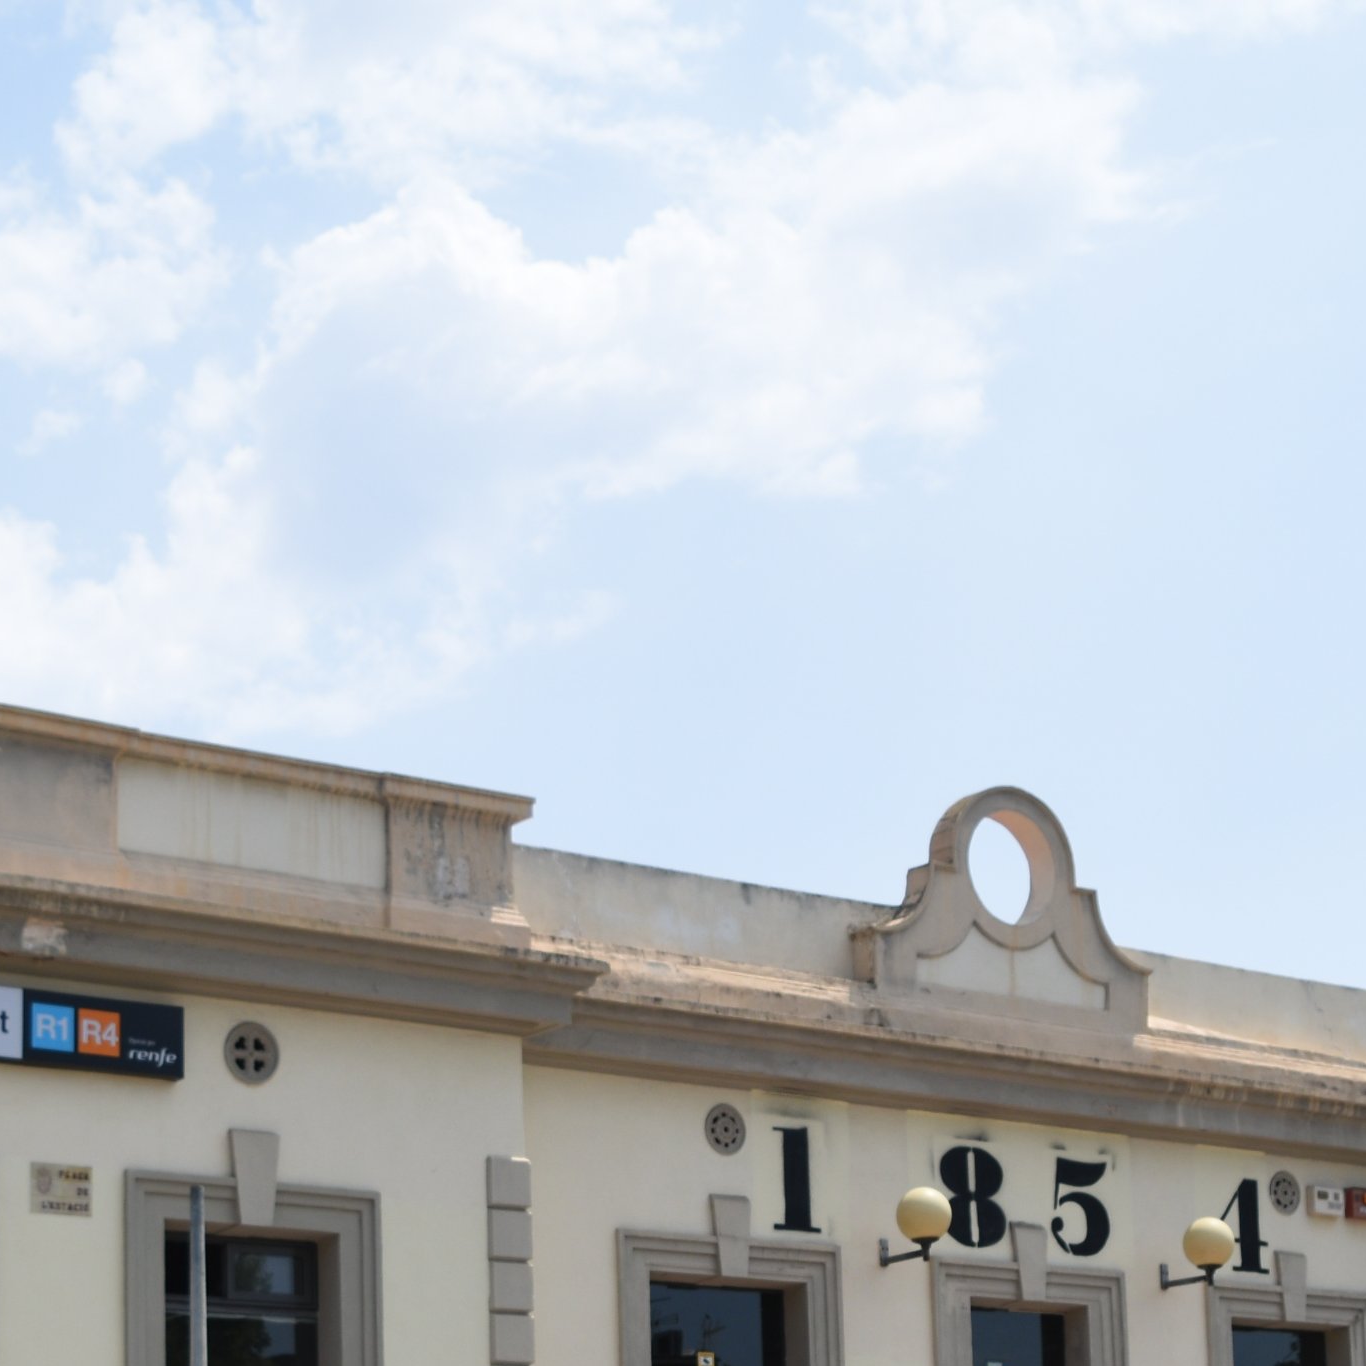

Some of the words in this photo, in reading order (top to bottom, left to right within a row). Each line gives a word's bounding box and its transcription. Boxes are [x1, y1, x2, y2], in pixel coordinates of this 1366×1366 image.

[36, 1012, 69, 1041] R1
[81, 1018, 119, 1047] R4
[128, 1048, 177, 1068] renfe
